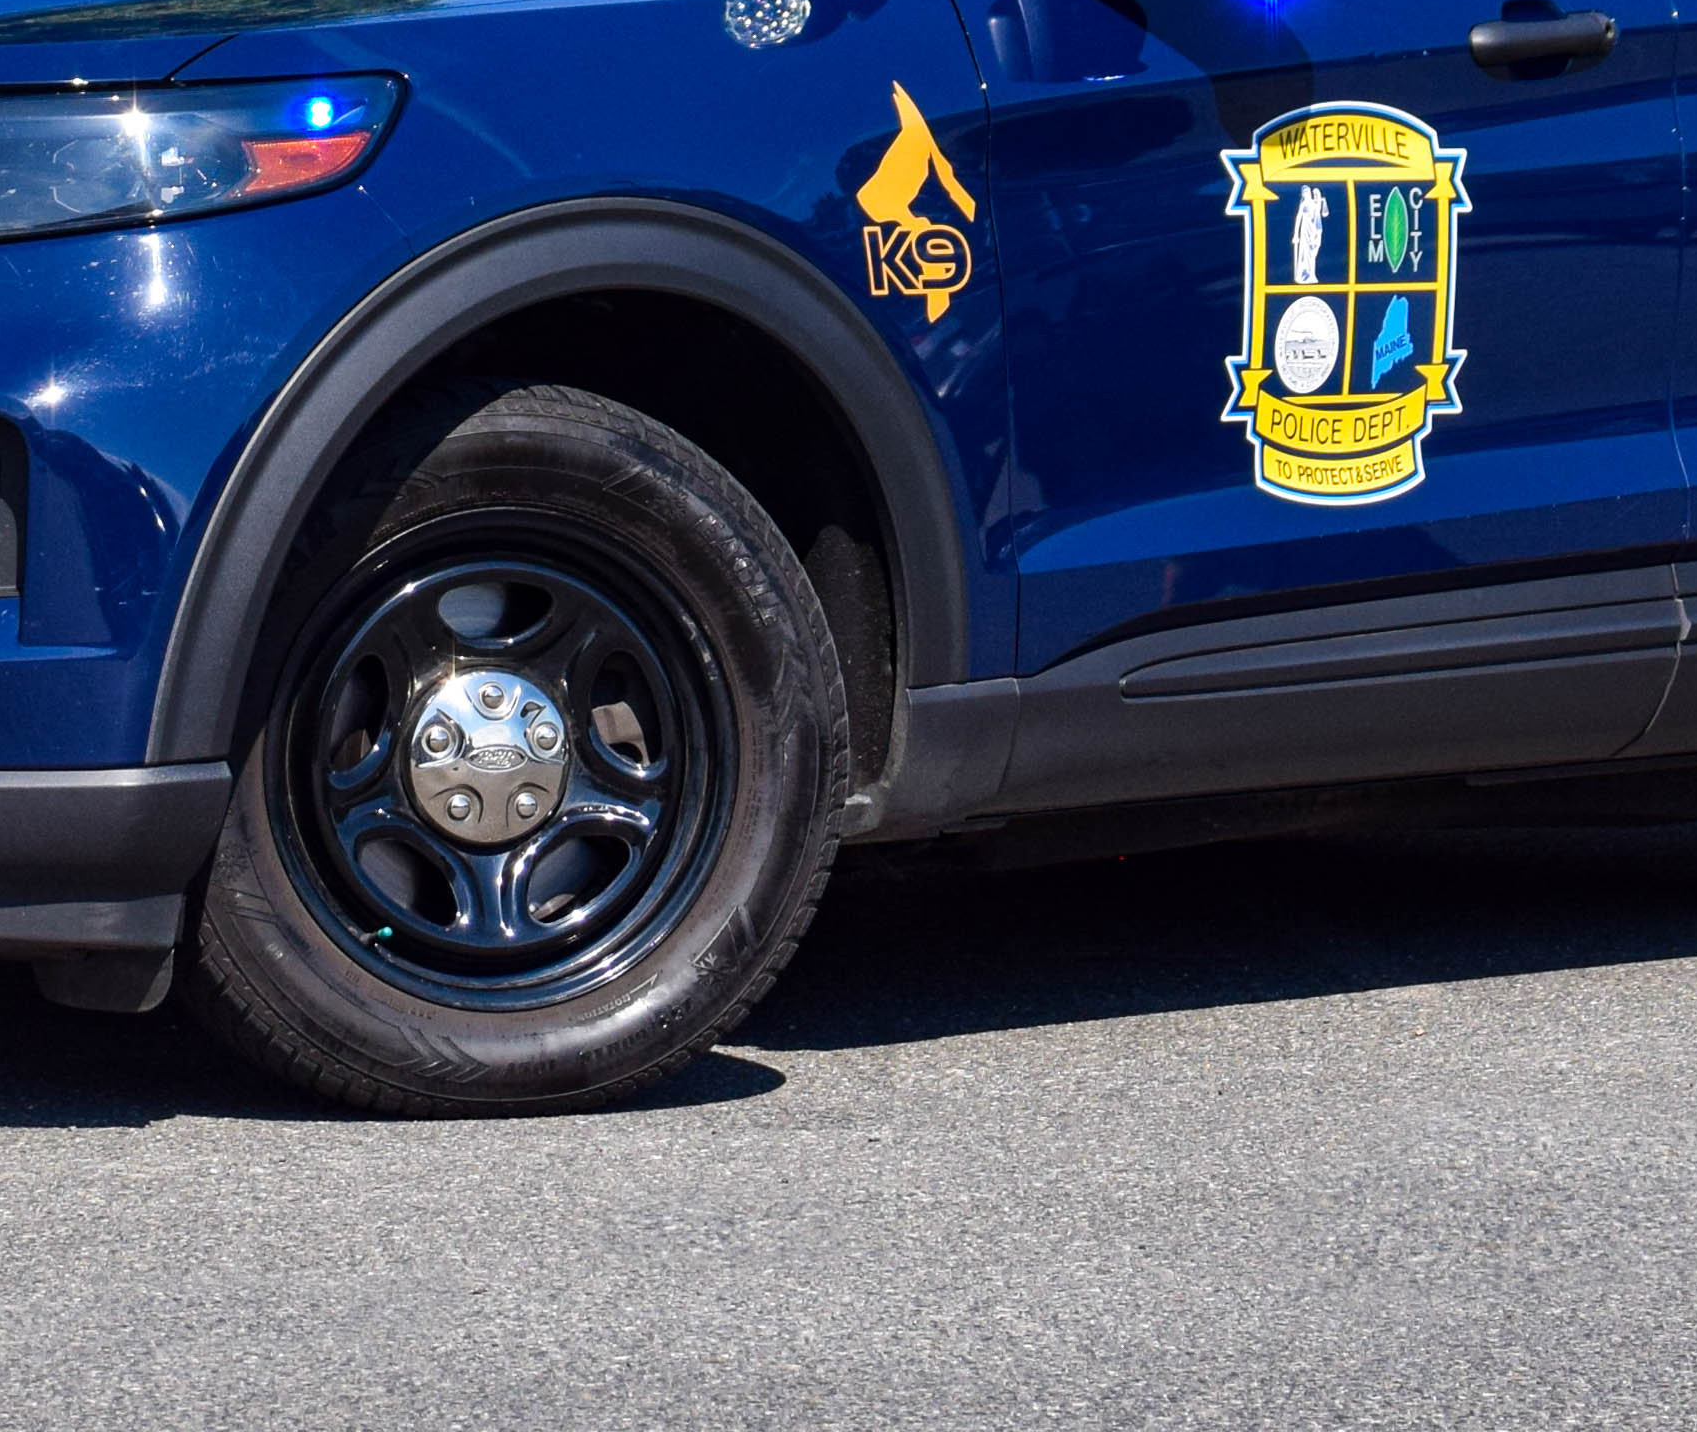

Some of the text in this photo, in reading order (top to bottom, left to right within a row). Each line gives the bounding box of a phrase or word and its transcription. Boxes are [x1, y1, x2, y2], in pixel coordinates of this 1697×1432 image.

[1278, 120, 1409, 160] WATERVILLE
[1368, 193, 1384, 263] ELM
[1408, 186, 1423, 272] CITY
[863, 224, 972, 296] K9
[1375, 335, 1408, 362] MAINE
[1270, 405, 1411, 446] POLICE DEPT.
[1275, 458, 1293, 481] TO
